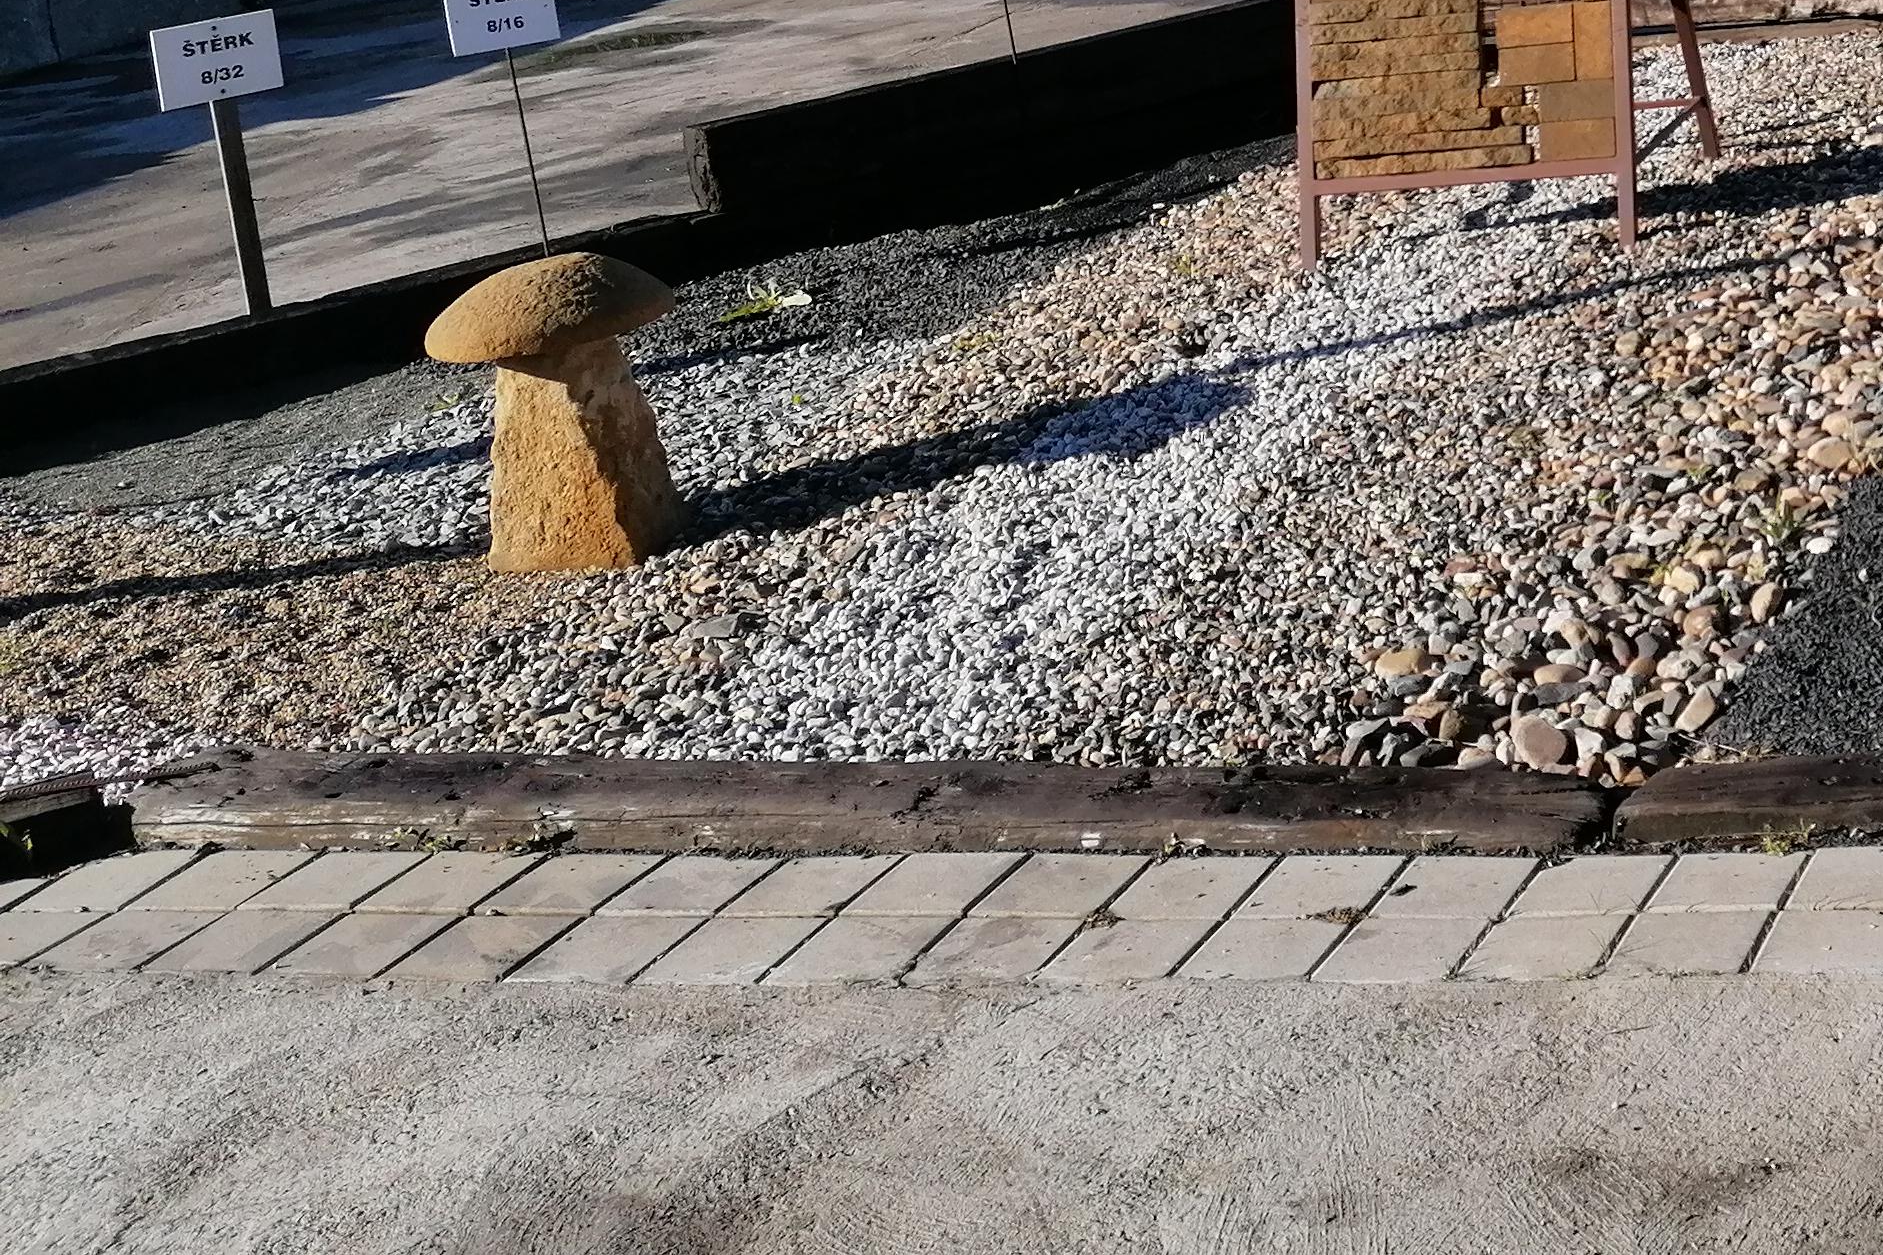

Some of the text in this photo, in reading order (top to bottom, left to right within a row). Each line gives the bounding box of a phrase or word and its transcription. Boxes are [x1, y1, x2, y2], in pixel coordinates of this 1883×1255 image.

[487, 15, 524, 33] 8/16
[182, 31, 254, 57] ŠTĚRK
[201, 64, 244, 85] 8/32
